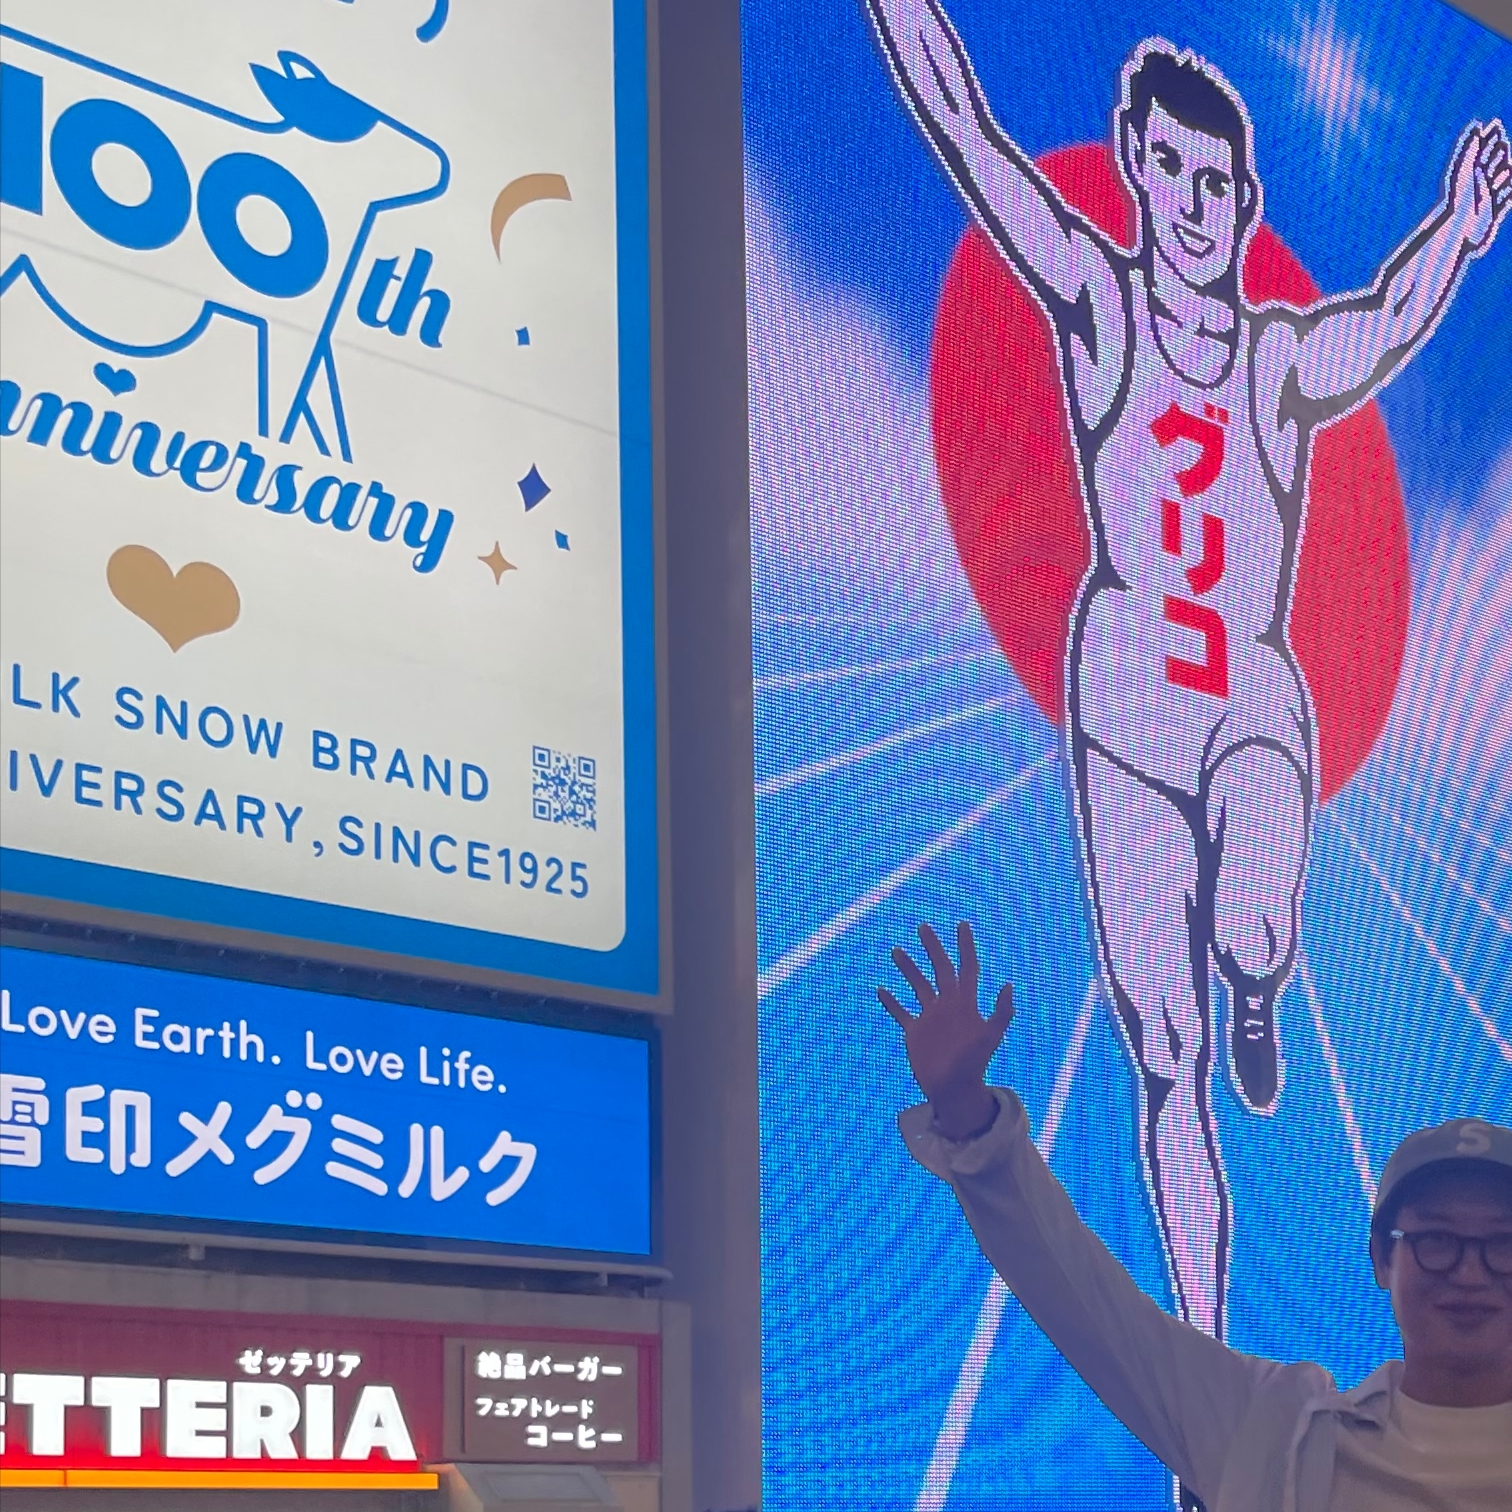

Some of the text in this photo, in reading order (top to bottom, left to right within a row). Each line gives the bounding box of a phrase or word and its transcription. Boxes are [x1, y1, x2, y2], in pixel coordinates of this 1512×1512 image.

[1149, 400, 1230, 699] グリコ
[114, 686, 284, 759] SNOW
[312, 730, 490, 802] BRAND
[0, 989, 508, 1094] Love Earth. Love Life.
[0, 1072, 538, 1208] 雪印メグミルク
[1456, 1122, 1493, 1155] S
[237, 1347, 363, 1379] ゼッテリア
[474, 1351, 624, 1382] 絶品バーガー
[0, 1372, 418, 1461] TTERIA
[474, 1397, 595, 1420] フェアトレード
[524, 1424, 624, 1450] コーヒー
